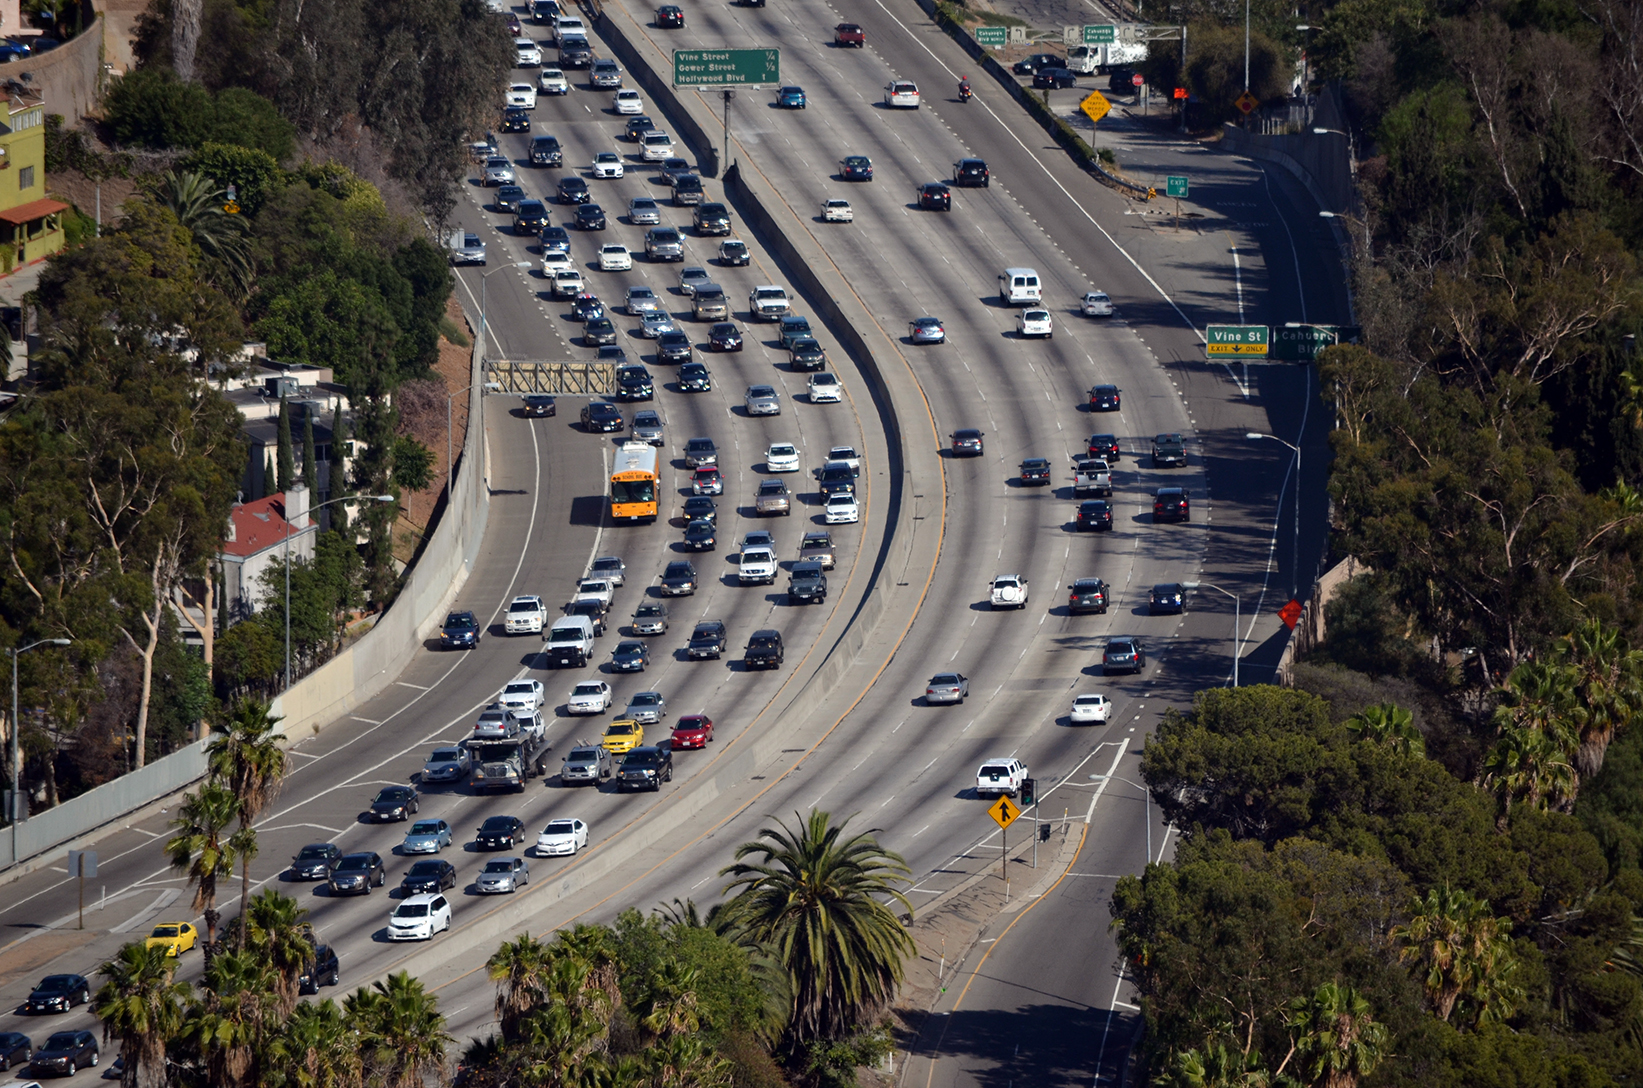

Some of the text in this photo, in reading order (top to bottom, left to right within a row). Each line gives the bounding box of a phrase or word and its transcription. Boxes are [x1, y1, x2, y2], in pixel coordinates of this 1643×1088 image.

[679, 74, 723, 83] Hollywood
[1214, 332, 1261, 341] Vine St
[1282, 331, 1339, 343] Cahueng
